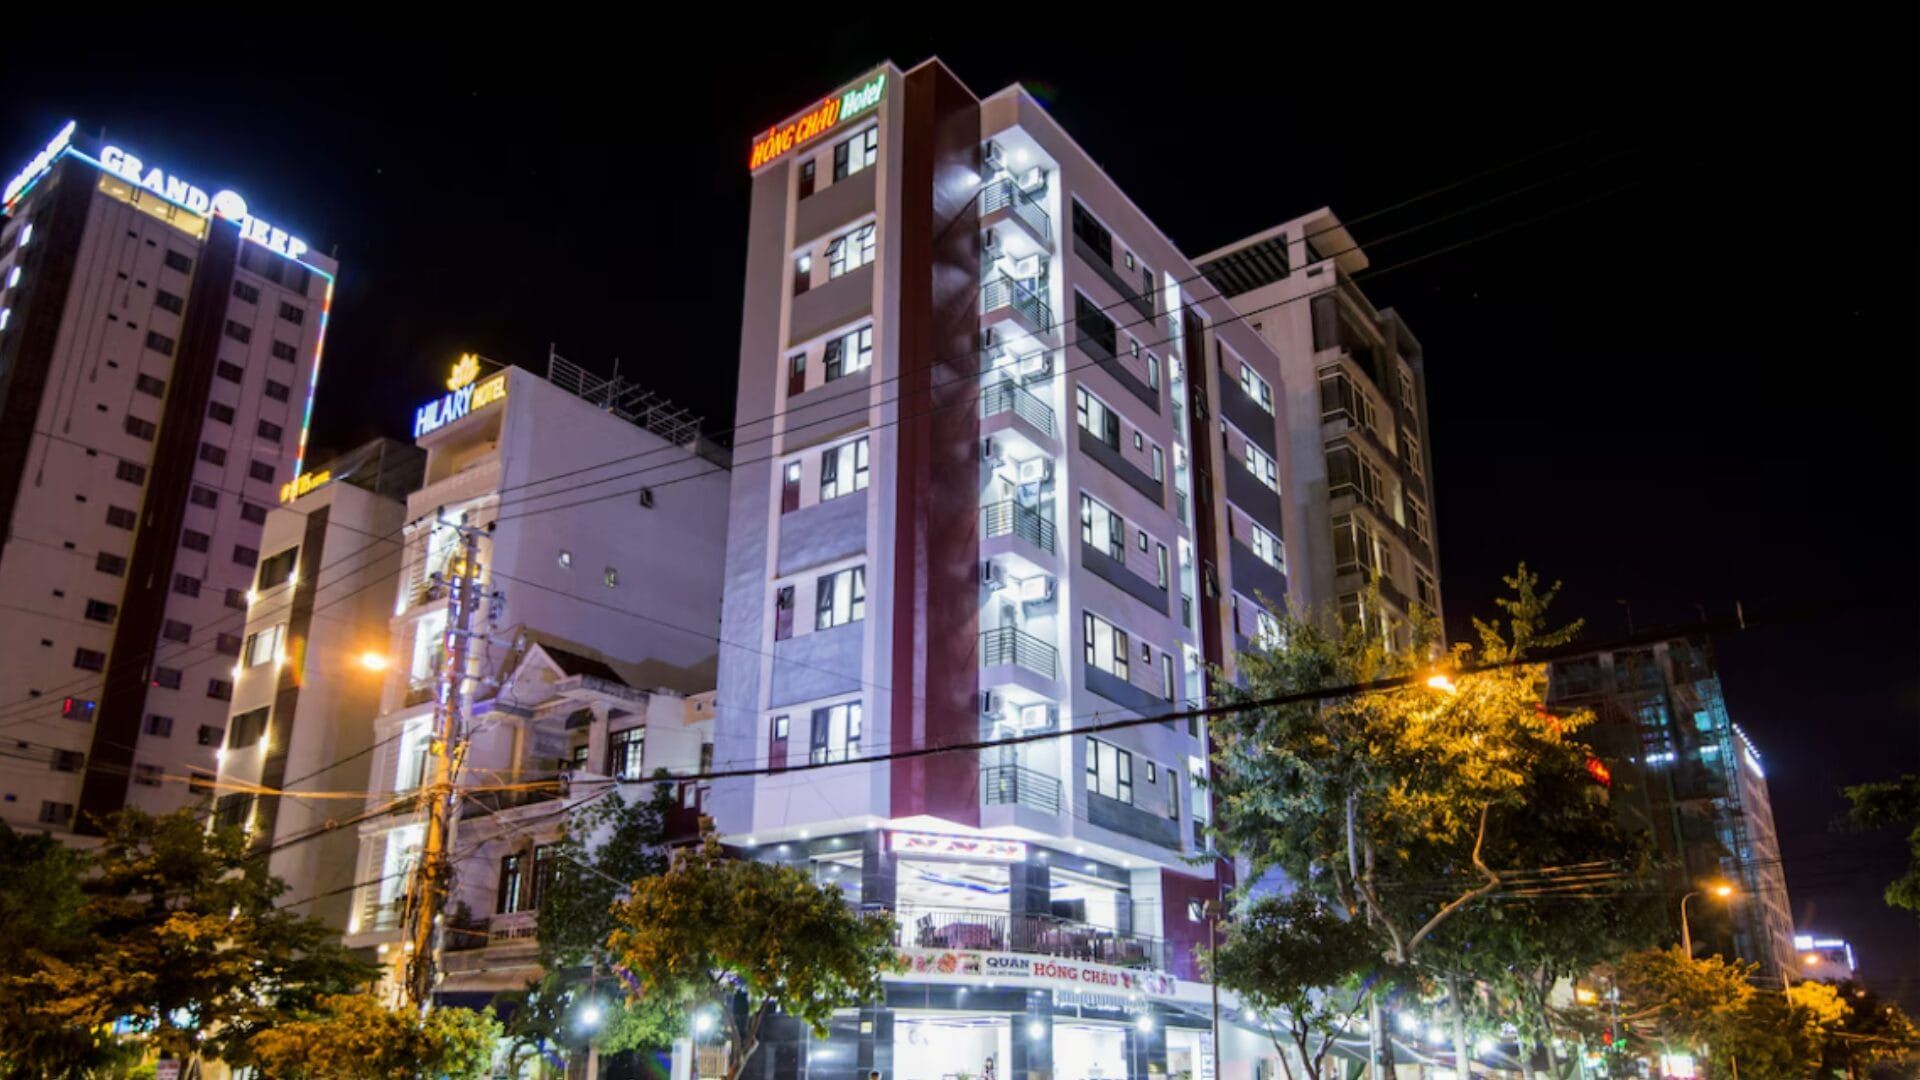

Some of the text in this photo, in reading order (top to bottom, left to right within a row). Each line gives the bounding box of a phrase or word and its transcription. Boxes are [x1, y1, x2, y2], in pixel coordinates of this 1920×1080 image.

[840, 74, 886, 120] Hotel
[100, 146, 209, 215] GRAND
[414, 375, 507, 438] HILARY HOTEL
